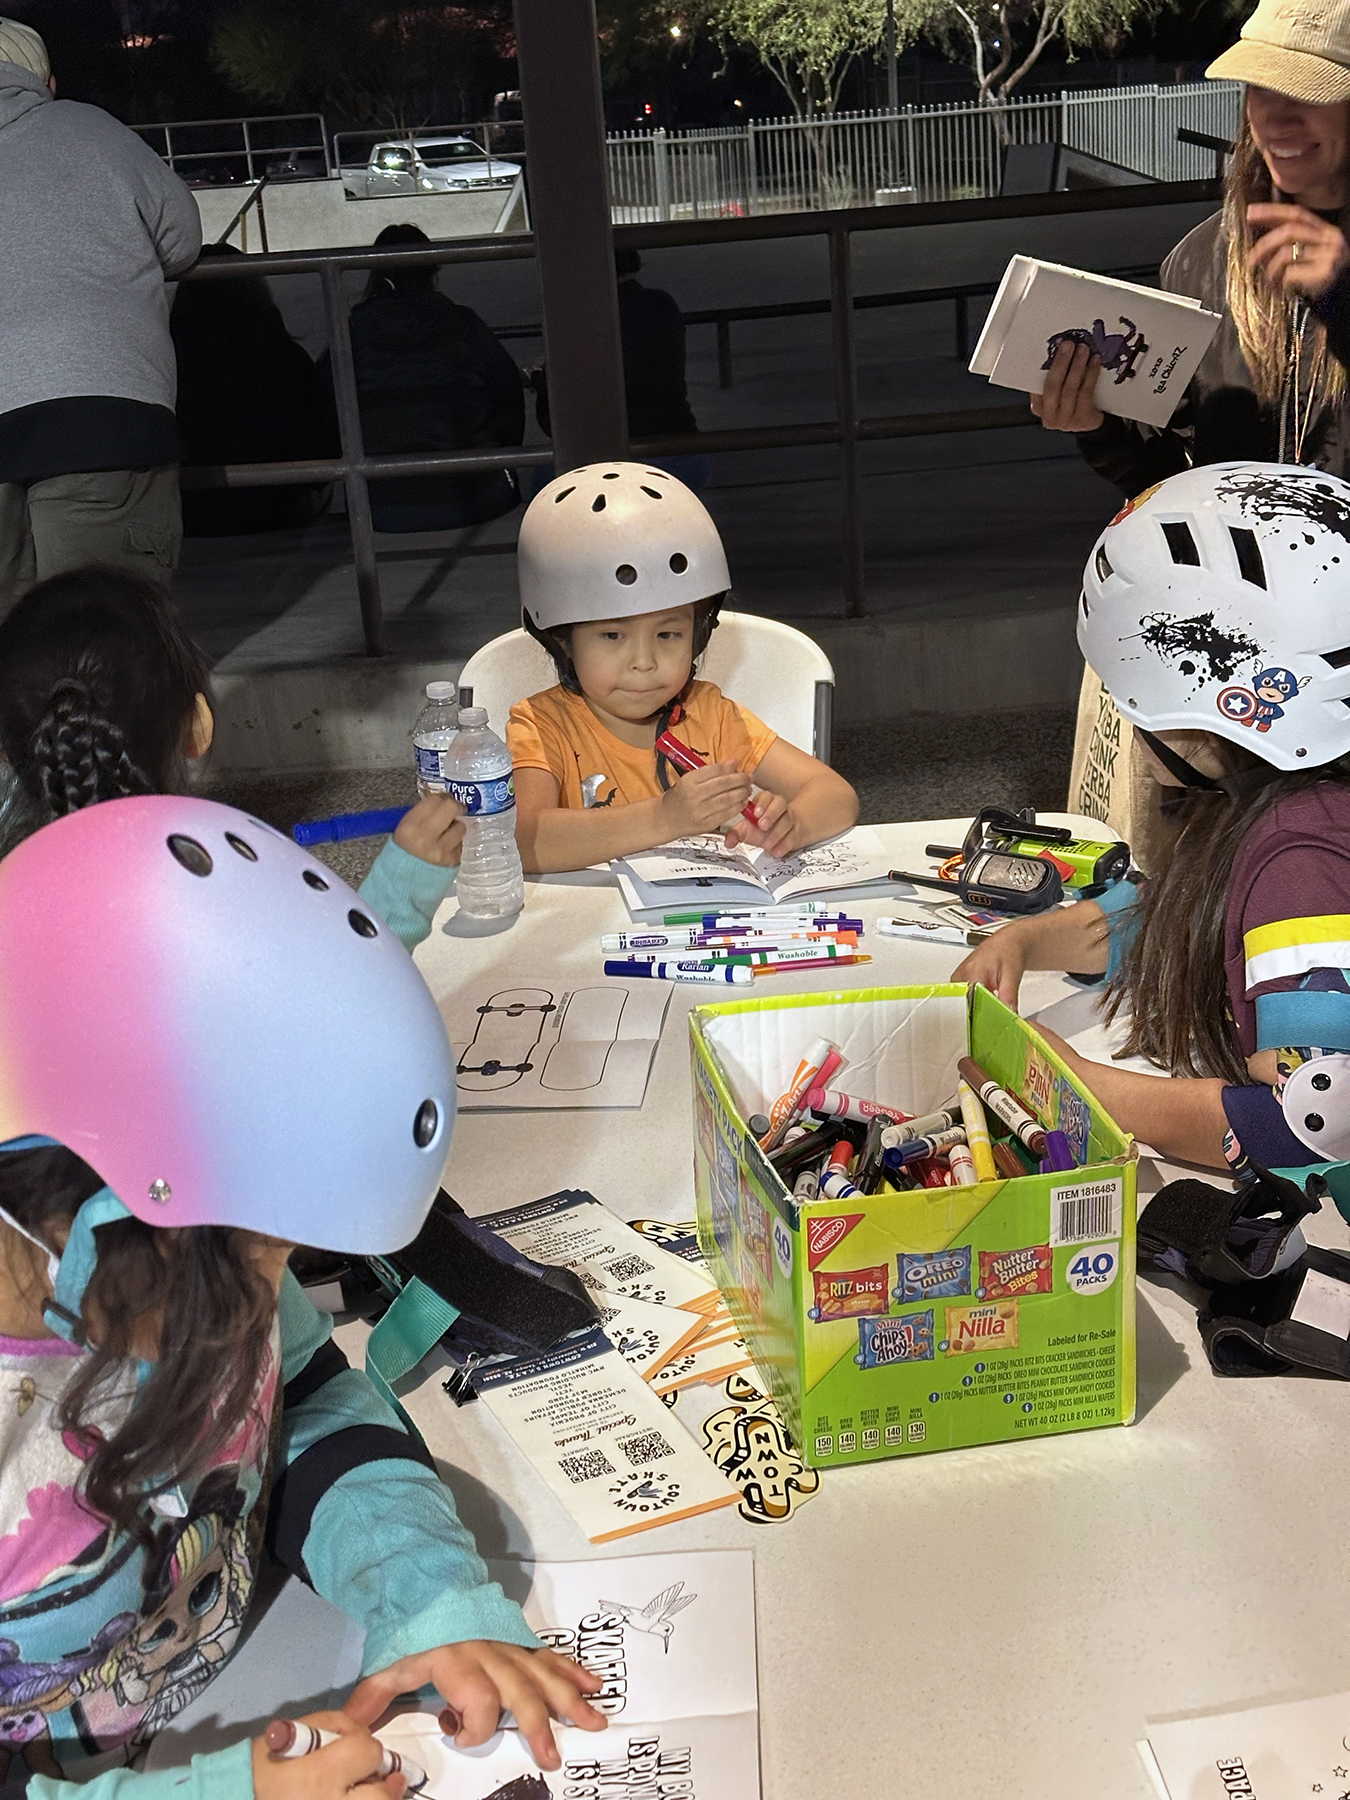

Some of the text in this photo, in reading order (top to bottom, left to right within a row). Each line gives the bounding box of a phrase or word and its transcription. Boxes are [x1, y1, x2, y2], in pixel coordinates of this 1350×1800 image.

[451, 782, 476, 794] Pure
[454, 793, 474, 805] Life
[778, 949, 818, 959] Washable
[1057, 1183, 1117, 1200] ITEM 1816483
[774, 1225, 791, 1262] 40
[813, 1221, 844, 1251] NABISCO
[907, 1259, 964, 1281] OREO
[992, 1250, 1035, 1275] Nutter
[1070, 1253, 1114, 1277] 40
[922, 1269, 958, 1288] mini
[1000, 1259, 1040, 1285] Butter
[1076, 1274, 1108, 1287] PACKS
[830, 1280, 883, 1297] RITZ bits
[1008, 1271, 1039, 1293] Bites
[969, 1307, 997, 1319] mini
[876, 1319, 902, 1331] Mini
[959, 1317, 1006, 1339] Nilla
[871, 1330, 906, 1352] Chips
[1048, 1328, 1115, 1346] Labeled for Re-Sale
[541, 1352, 583, 1369] COWTOWN
[545, 1349, 578, 1362] University
[989, 1361, 996, 1370] OZ
[1010, 1357, 1023, 1368] PACKS
[1024, 1356, 1034, 1366] RITZ
[1035, 1355, 1044, 1364] BITS
[1045, 1352, 1065, 1362] CRACKER
[1066, 1348, 1095, 1360] SANDWICHES
[1099, 1344, 1115, 1355] CHEESE
[977, 1375, 984, 1383] OZ
[997, 1371, 1011, 1381] PACKS
[1013, 1369, 1026, 1378] OREO
[1028, 1367, 1039, 1376] MINI
[1040, 1363, 1068, 1375] CHOCOLATE
[1068, 1359, 1094, 1371] SANDWICH
[1095, 1356, 1115, 1367] COOKIES
[510, 1374, 559, 1392] FOUNDATION
[549, 1371, 587, 1386] BUILDING
[944, 1391, 950, 1400] OZ
[963, 1387, 977, 1397] PACKS
[978, 1385, 996, 1395] NUTTER
[998, 1382, 1015, 1392] BUTTER
[1017, 1380, 1029, 1390] BITES
[1030, 1378, 1049, 1388] PEANUT
[1050, 1375, 1068, 1385] BUTTER
[1069, 1371, 1094, 1383] SANDWICH
[1095, 1368, 1115, 1379] COOKIES
[507, 1382, 549, 1398] PRODUCTS
[554, 1387, 573, 1396] YETI
[1038, 1388, 1052, 1398] PACKS
[1053, 1387, 1064, 1396] MINI
[1064, 1385, 1078, 1395] CHIPS
[1095, 1379, 1115, 1390] COOKIES
[529, 1396, 580, 1415] FOUNDATION
[546, 1394, 569, 1404] FUND
[556, 1400, 586, 1412] PUBLIC
[590, 1399, 610, 1408] CITY
[597, 1402, 617, 1412] CITY
[1037, 1401, 1044, 1410] OZ
[1057, 1397, 1072, 1407] PACKS
[1073, 1396, 1083, 1405] MINI
[1084, 1394, 1097, 1403] NILLA
[1098, 1391, 1115, 1401] WAFERS
[522, 1409, 556, 1423] AFFAIRS
[547, 1409, 578, 1421] TEMPE
[548, 1412, 585, 1427] PHOENIX
[1014, 1418, 1025, 1428] NET
[1028, 1417, 1038, 1426] WT
[1039, 1415, 1047, 1424] 40
[1049, 1414, 1057, 1423] OZ
[1059, 1413, 1065, 1423] (2
[1067, 1412, 1074, 1421] LB
[1082, 1409, 1093, 1419] OZ)
[1095, 1406, 1114, 1418] 1.12kg
[552, 1413, 640, 1449] Special Thanks
[613, 1426, 654, 1441] INSTAGRAM
[864, 1430, 878, 1439] 140
[886, 1426, 901, 1436] 140
[910, 1423, 924, 1433] 130
[817, 1437, 832, 1447] 150
[840, 1434, 855, 1443] 140
[613, 1482, 681, 1513] COWTOWN
[627, 1735, 660, 1759] IS
[657, 1746, 691, 1775] MY
[564, 1758, 600, 1781] IS
[598, 1758, 630, 1786] MY
